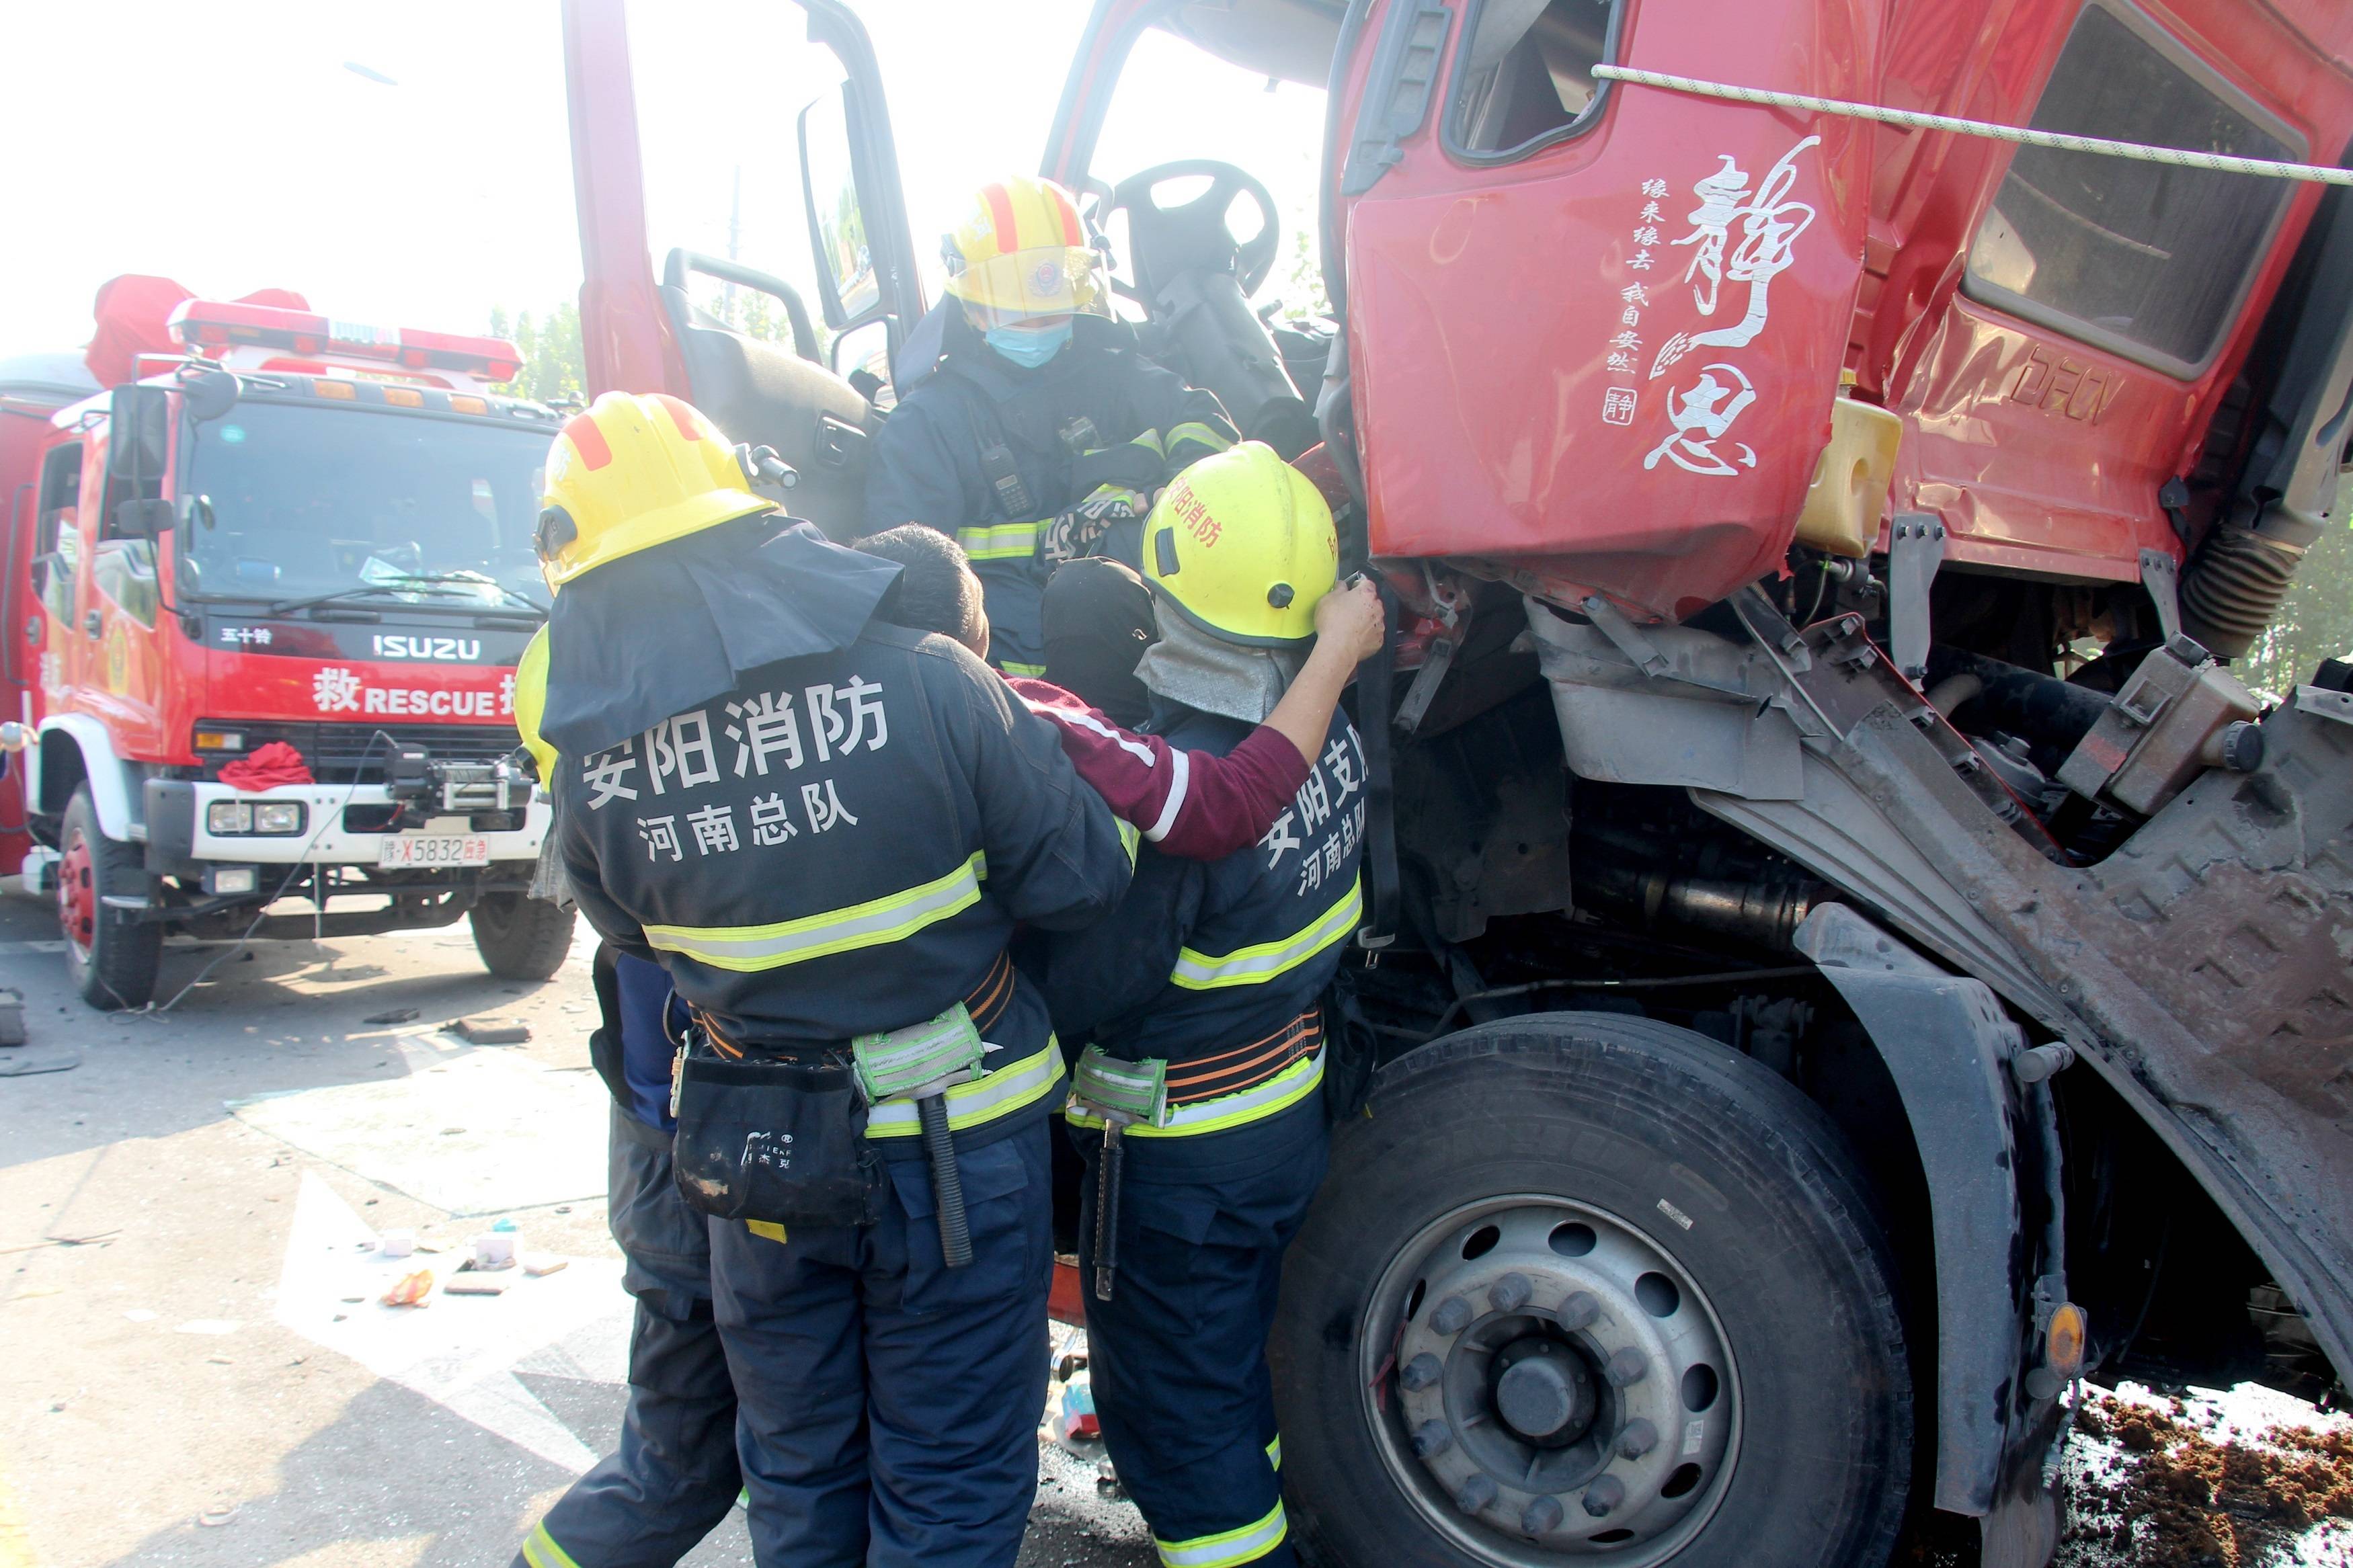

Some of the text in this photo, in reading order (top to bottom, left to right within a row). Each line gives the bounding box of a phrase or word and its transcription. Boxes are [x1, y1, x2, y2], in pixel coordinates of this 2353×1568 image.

[1606, 178, 1671, 375] 缘来缘去 我自安然
[1604, 390, 1635, 422] 静
[221, 627, 273, 645] 五十铃
[372, 634, 481, 661] ISUZU
[312, 667, 362, 712] 救
[364, 688, 495, 716] RESCUE
[582, 674, 889, 811] 安阳消防
[636, 778, 859, 863] 河南总队
